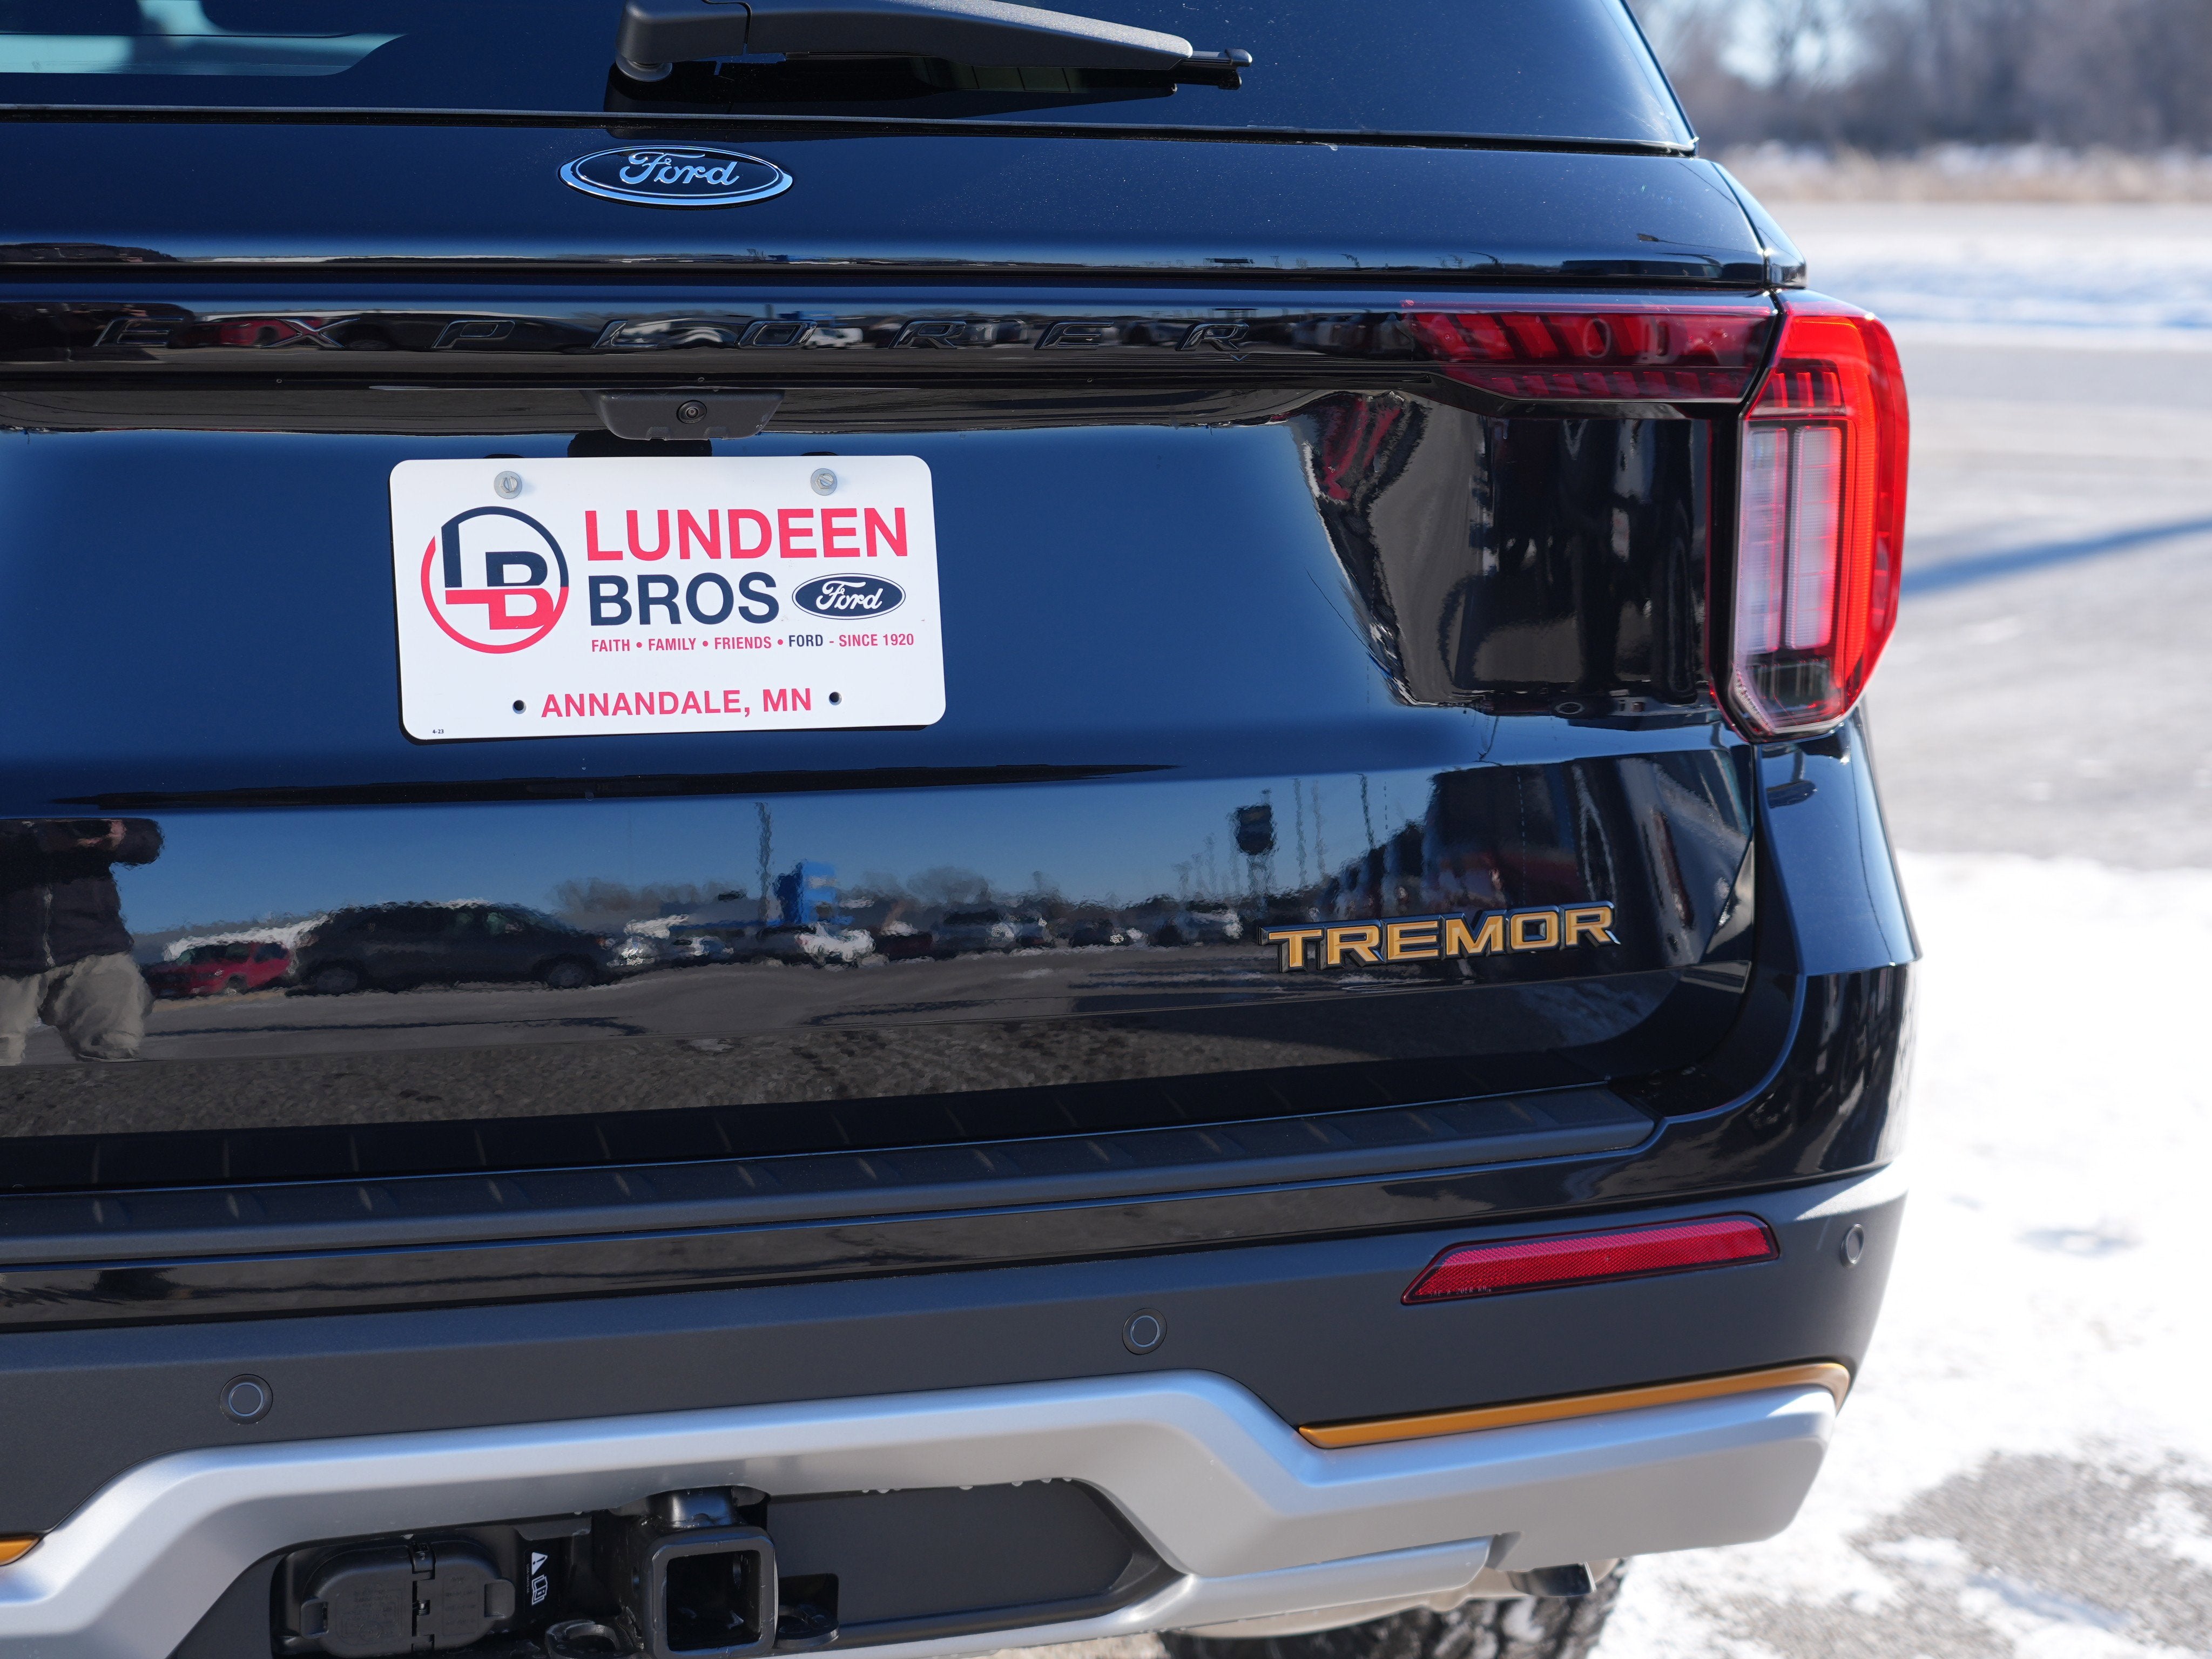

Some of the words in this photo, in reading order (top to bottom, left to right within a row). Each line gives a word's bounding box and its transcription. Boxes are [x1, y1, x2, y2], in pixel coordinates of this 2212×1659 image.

[619, 151, 740, 185] Ford
[93, 315, 1250, 351] EXPLORER
[585, 508, 907, 561] LUNDEEN
[588, 571, 779, 626] BROS
[815, 580, 884, 610] Ford
[591, 639, 630, 652] FAITH
[648, 638, 697, 651] FAMILY
[714, 636, 772, 650] FRIENDS
[788, 634, 824, 648] FORD
[839, 633, 878, 647] SINCE
[882, 633, 914, 646] 1920
[541, 690, 750, 718] ANNANDALE,
[763, 687, 811, 712] MN
[1259, 900, 1620, 972] TREMOR
